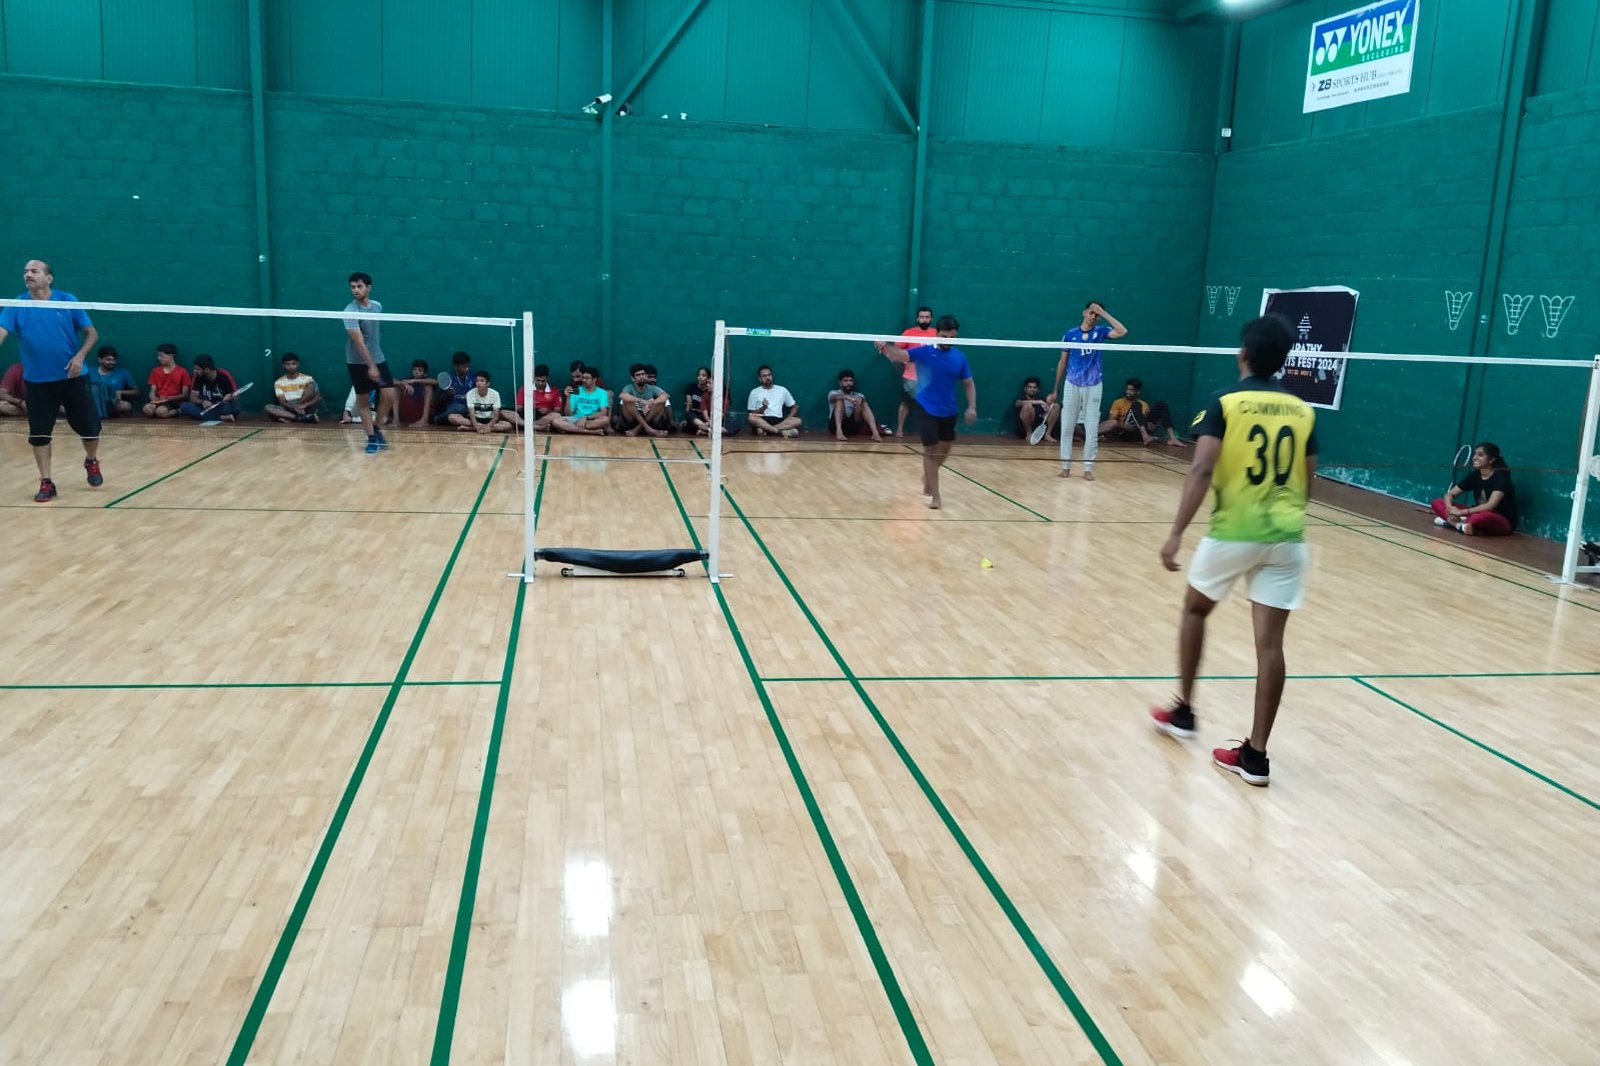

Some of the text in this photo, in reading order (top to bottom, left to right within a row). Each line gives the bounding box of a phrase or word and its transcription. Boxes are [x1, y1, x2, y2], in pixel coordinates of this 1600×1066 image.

[1350, 1, 1411, 56] YONEX
[1332, 75, 1359, 89] SPORTS
[1360, 70, 1377, 83] HUB
[1291, 343, 1322, 352] PATHY
[1297, 357, 1317, 368] FEST
[1317, 359, 1338, 370] 2024
[1246, 424, 1295, 486] 30
